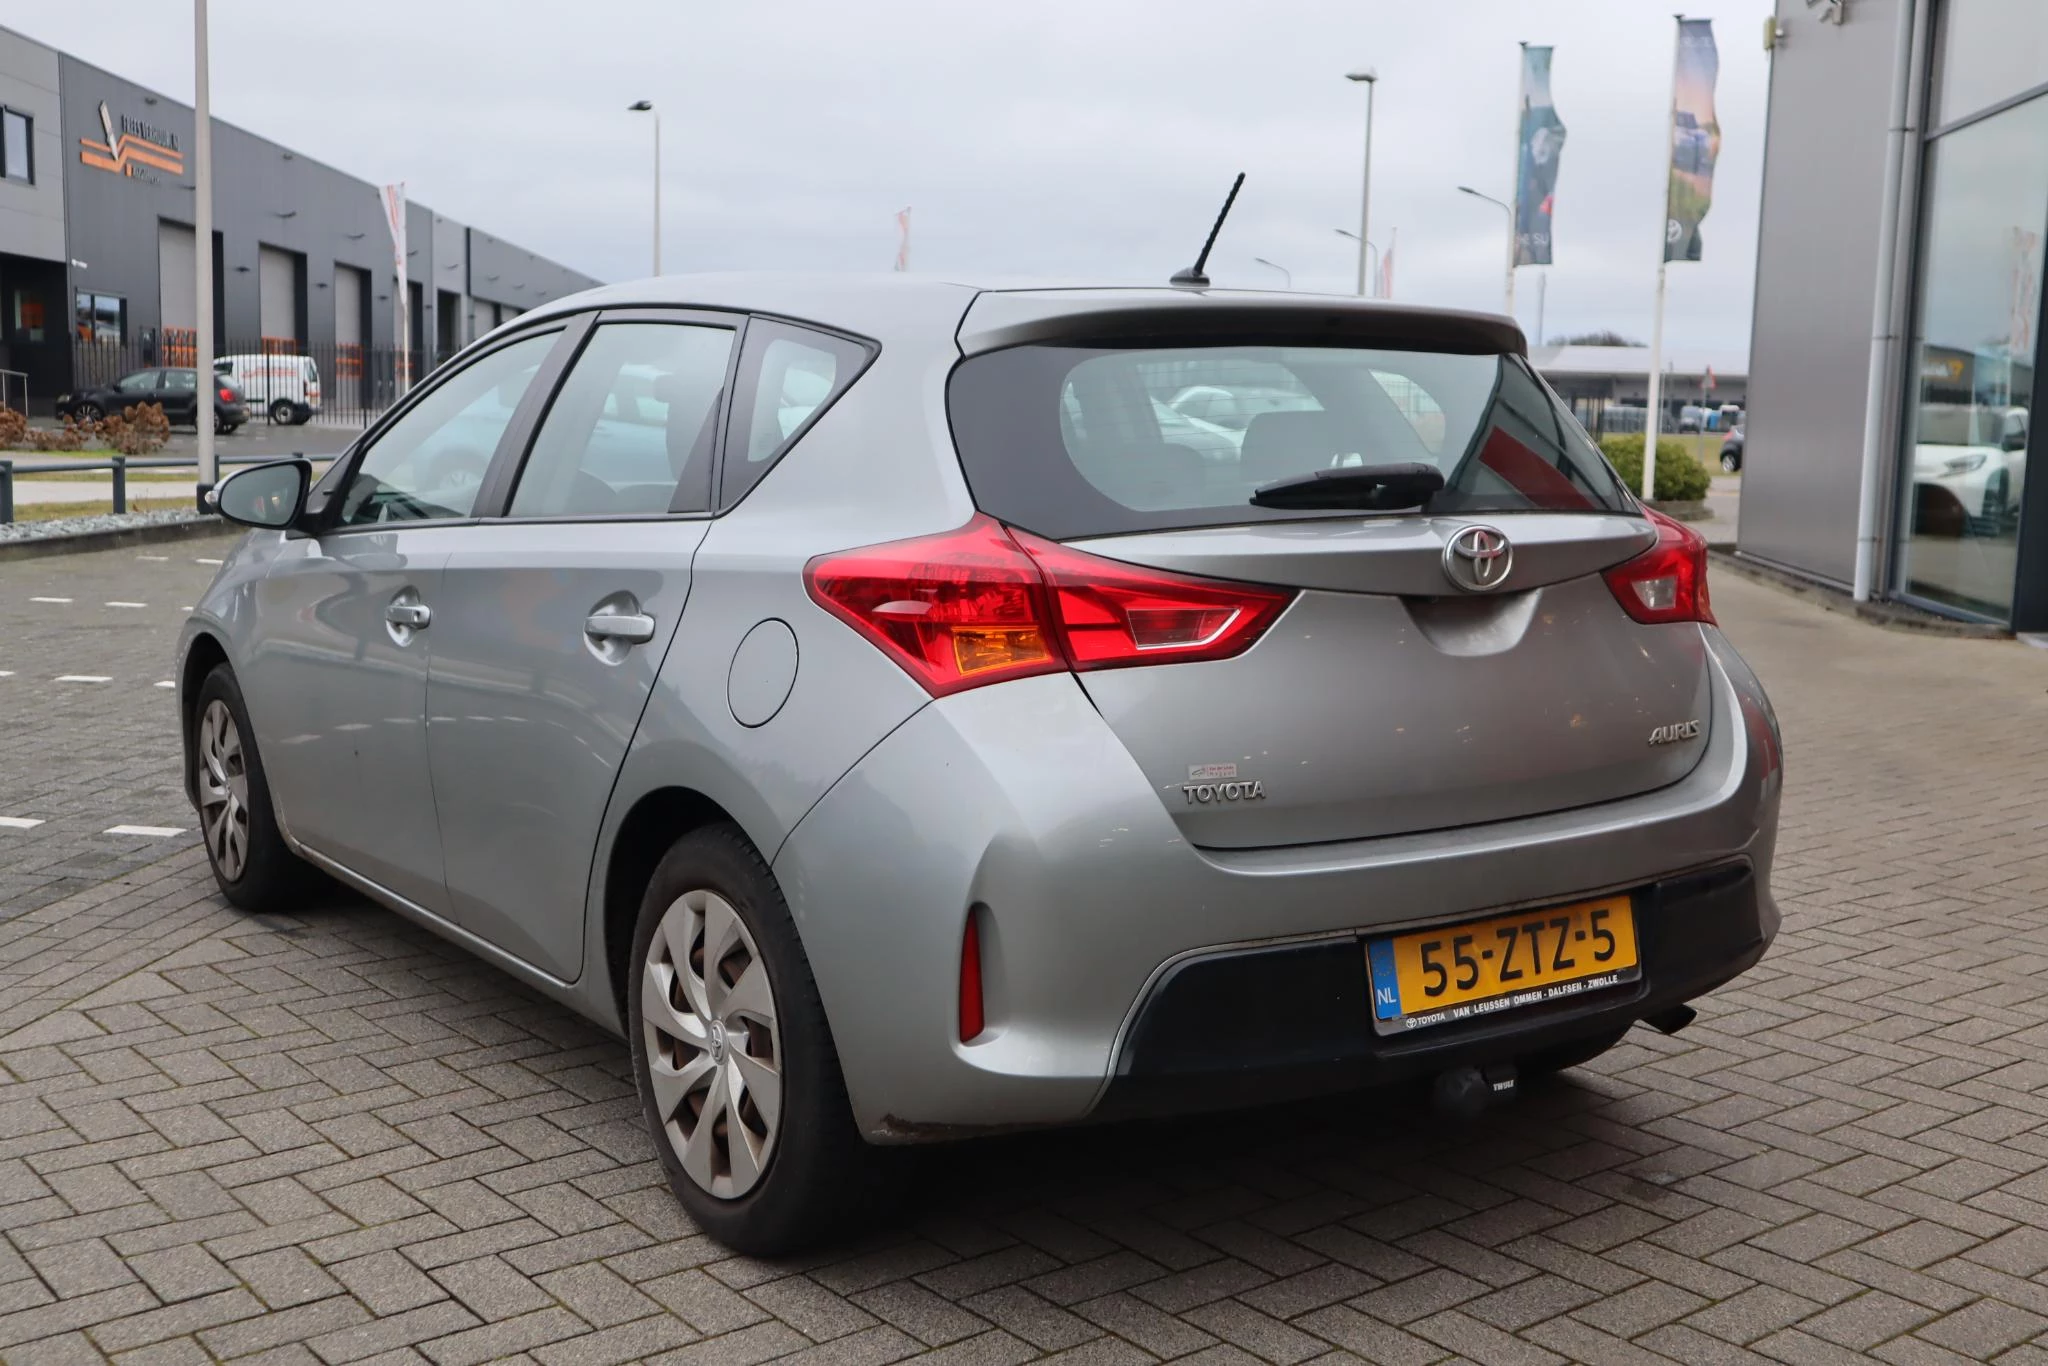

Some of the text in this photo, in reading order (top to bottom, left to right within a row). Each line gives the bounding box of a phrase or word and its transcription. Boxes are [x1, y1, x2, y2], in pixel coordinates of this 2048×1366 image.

[1648, 719, 1701, 746] AURIS
[1182, 780, 1266, 804] TOYOTA
[1420, 908, 1616, 997] 55-ZTZ-5
[1377, 987, 1397, 1006] NL
[1417, 1012, 1446, 1025] TOYOTA
[1453, 1006, 1470, 1018] VAN
[1473, 997, 1510, 1013] LEUSSEN
[1513, 990, 1543, 1004] OMMEN
[1548, 982, 1582, 997] DALFSEN
[1587, 974, 1618, 988] ZWOLLE
